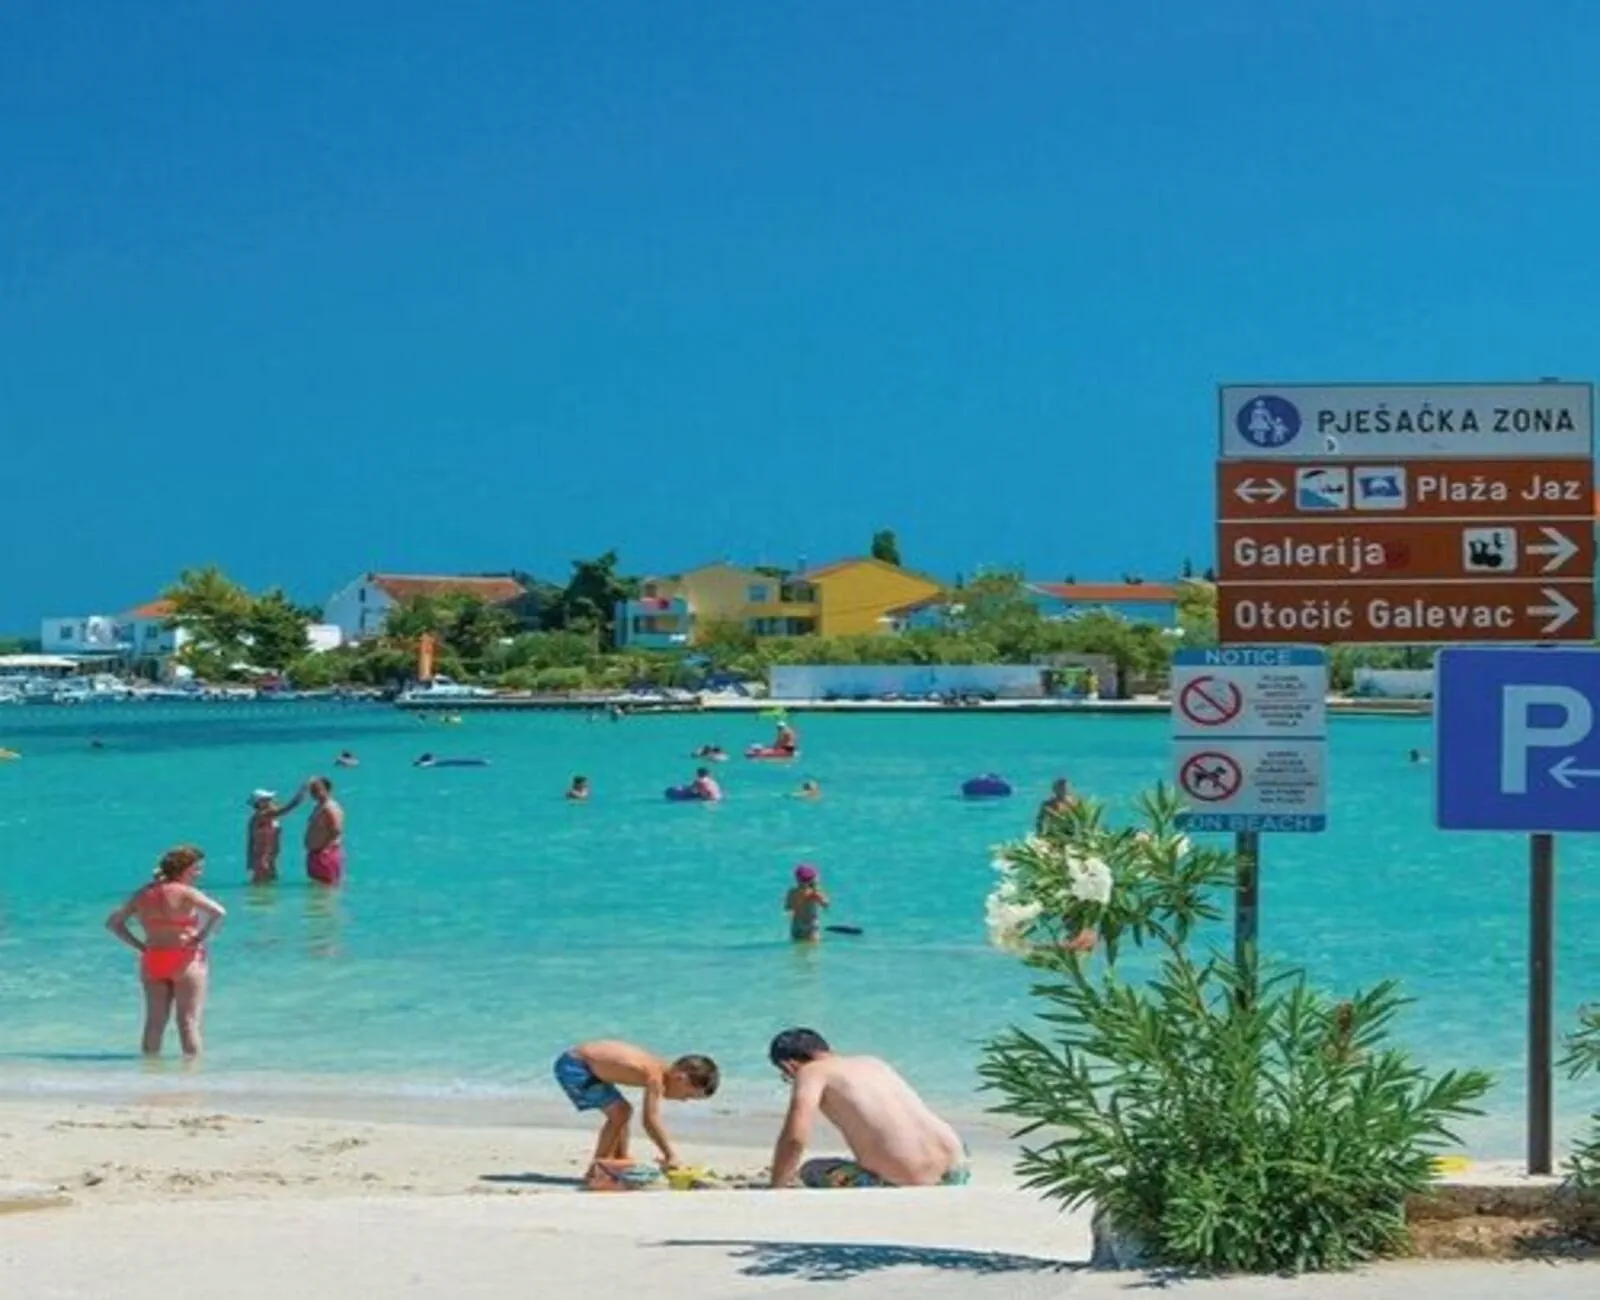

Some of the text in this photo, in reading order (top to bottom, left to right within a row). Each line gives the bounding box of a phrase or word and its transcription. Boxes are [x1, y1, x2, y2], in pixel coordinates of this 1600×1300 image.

[1493, 408, 1575, 432] ZONA
[1416, 474, 1582, 502] Plaža Jaz
[1233, 537, 1386, 573] Galerija
[1233, 600, 1514, 630] Otočić Galevac
[1205, 649, 1290, 665] NOTICE
[1501, 684, 1593, 794] P
[1229, 815, 1311, 831] BEACH
